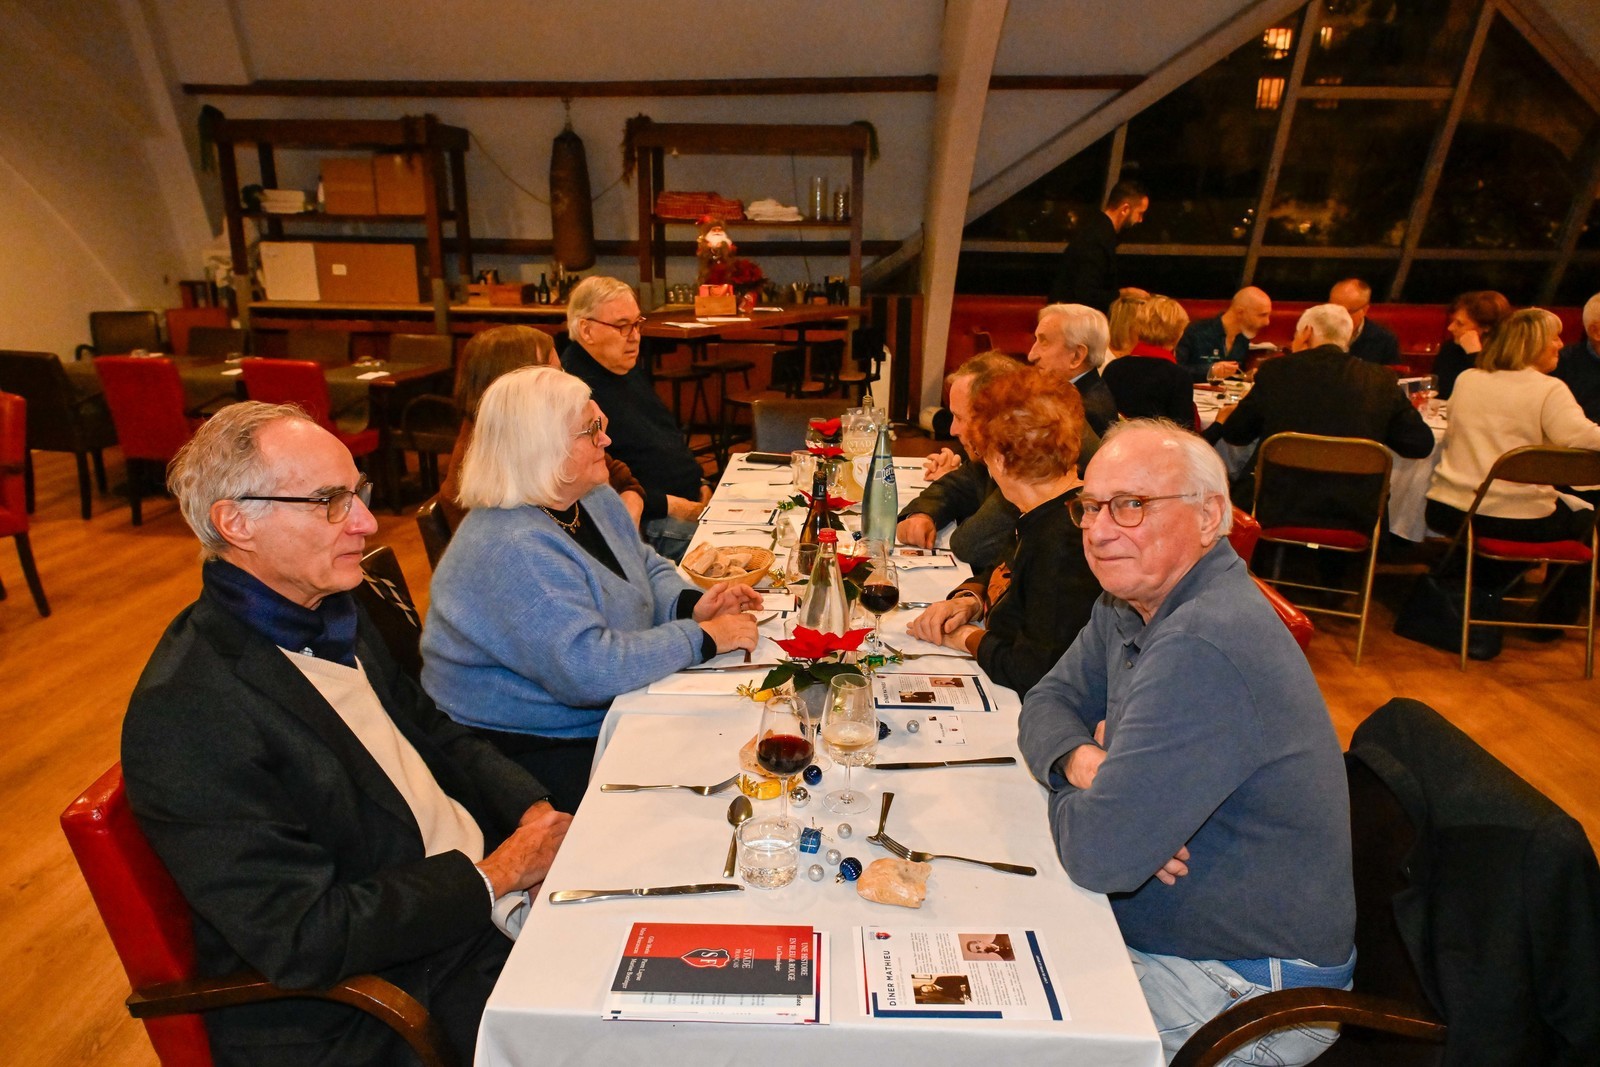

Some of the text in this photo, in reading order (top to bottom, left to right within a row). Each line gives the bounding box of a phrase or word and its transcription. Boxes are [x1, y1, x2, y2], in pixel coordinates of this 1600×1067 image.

[741, 949, 752, 969] STADE
[788, 963, 796, 981] ROUGE
[883, 950, 897, 1006] DÎNER MATHIEU
